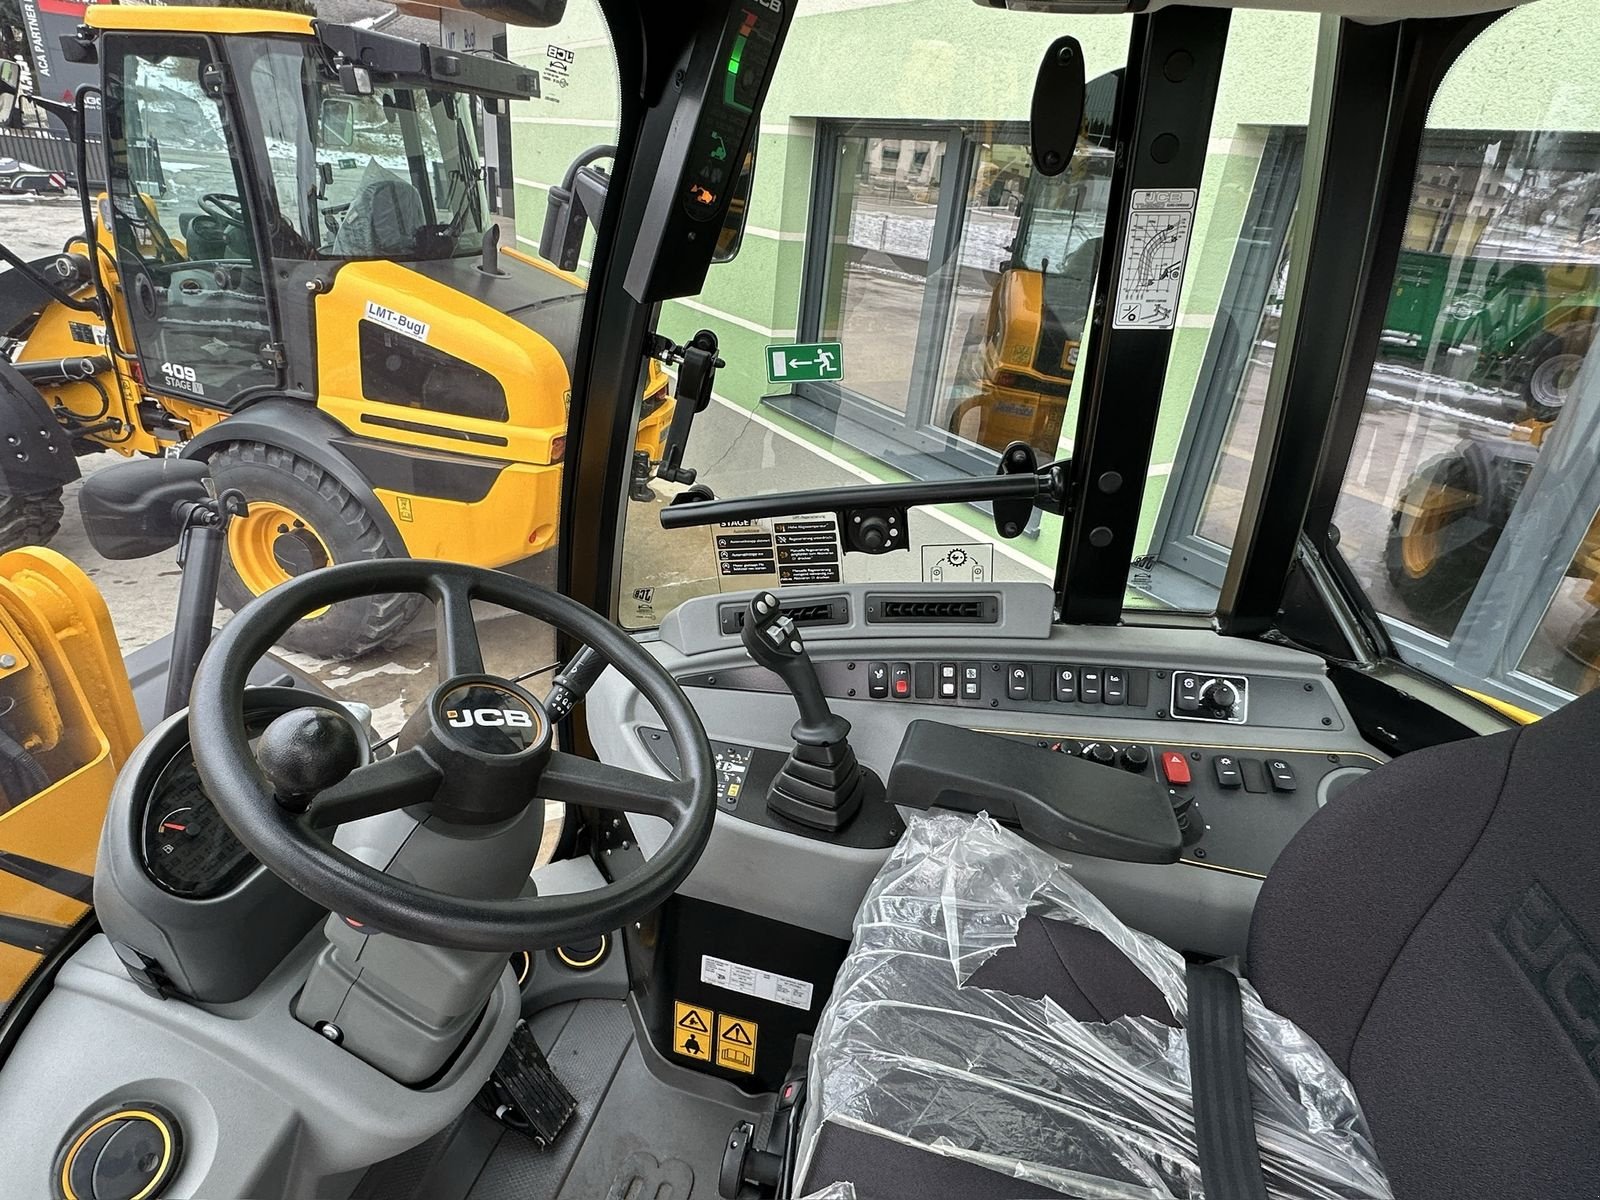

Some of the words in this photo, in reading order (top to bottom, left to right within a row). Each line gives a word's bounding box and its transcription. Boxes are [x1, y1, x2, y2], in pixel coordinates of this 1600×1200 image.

[25, 4, 45, 54] PARTNER
[37, 55, 50, 77] ACA
[1145, 191, 1183, 203] JCB
[368, 303, 426, 335] LMT-Bugl
[161, 362, 197, 382] 409
[165, 376, 192, 391] STAGE
[446, 708, 533, 728] JCB
